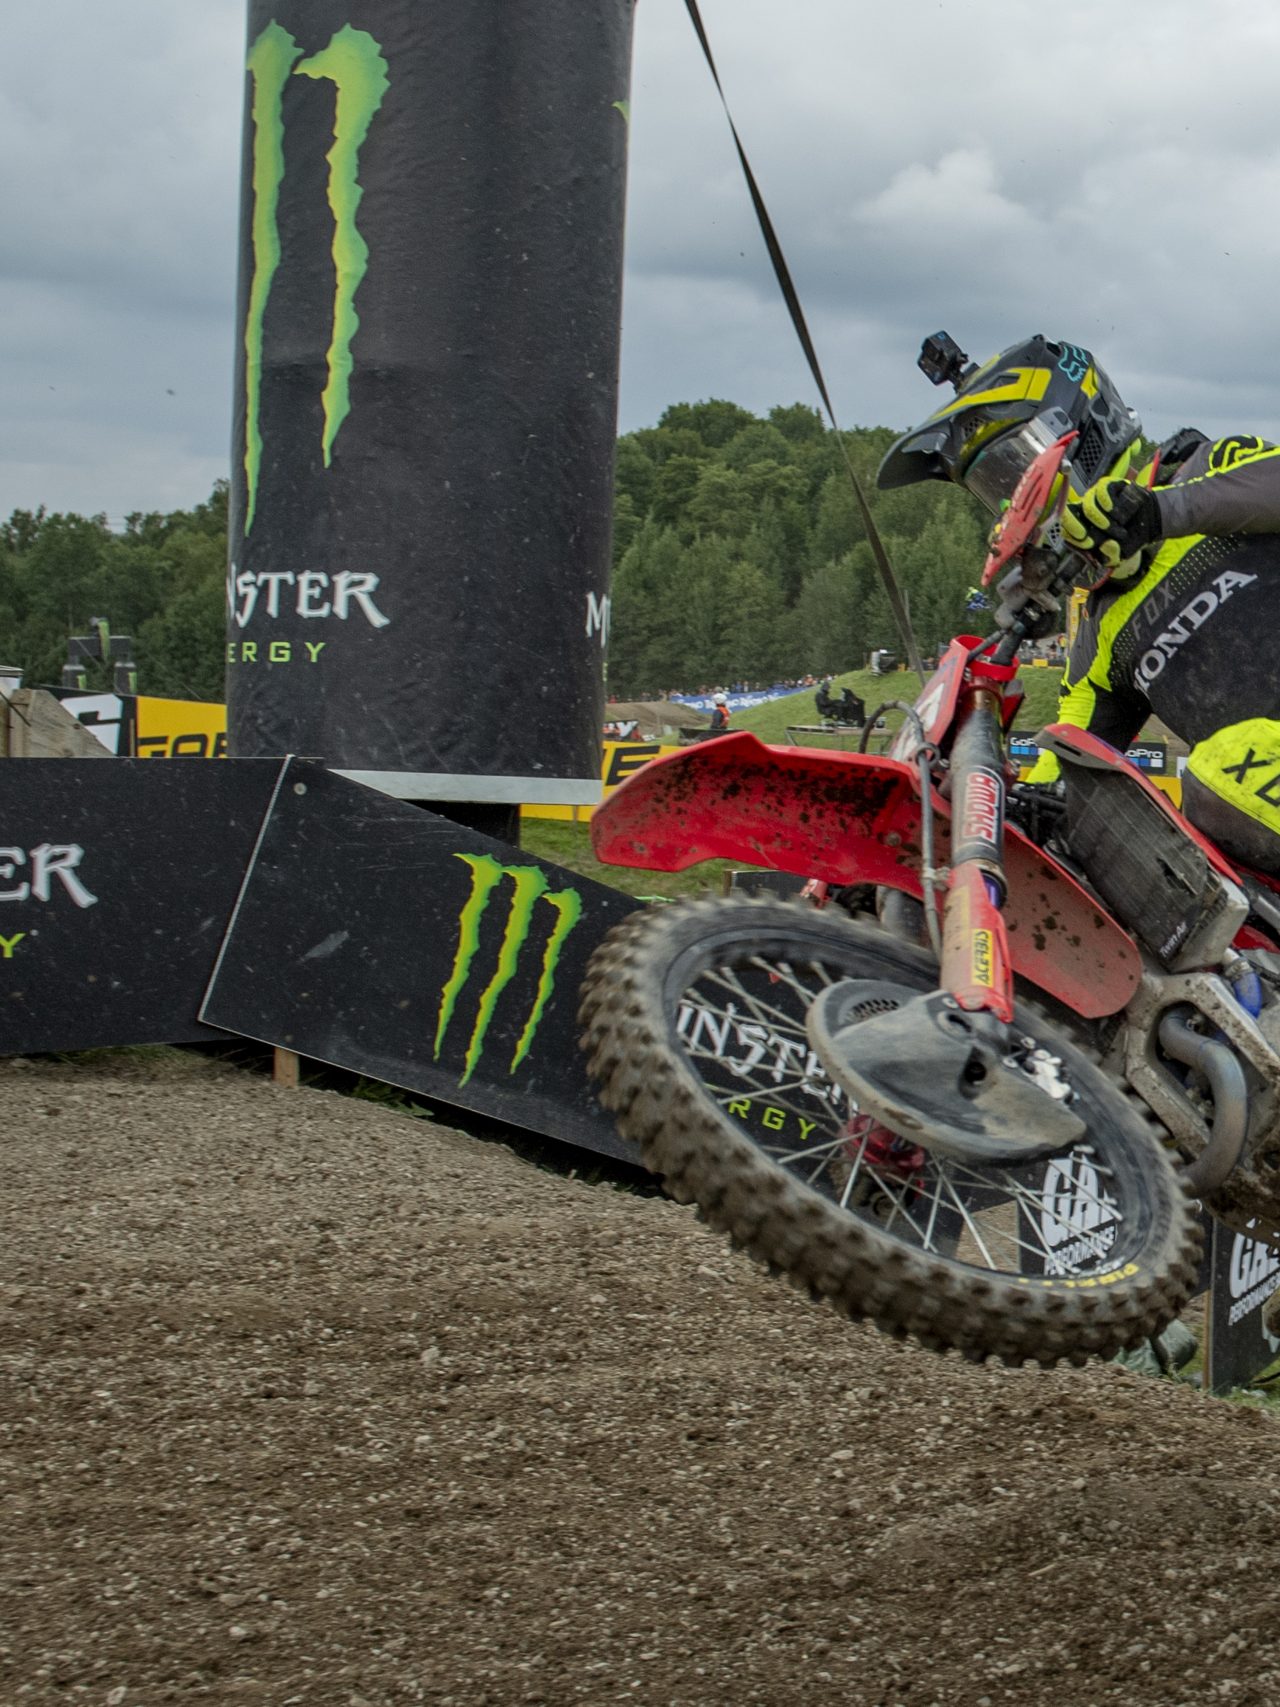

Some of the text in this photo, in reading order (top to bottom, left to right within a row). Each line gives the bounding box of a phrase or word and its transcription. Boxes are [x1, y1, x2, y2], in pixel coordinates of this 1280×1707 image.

[1131, 579, 1176, 641] FOX
[1125, 749, 1164, 758] oPro
[963, 772, 999, 843] SHOWA
[975, 930, 990, 986] ACERBIS
[704, 1083, 816, 1140] RGY
